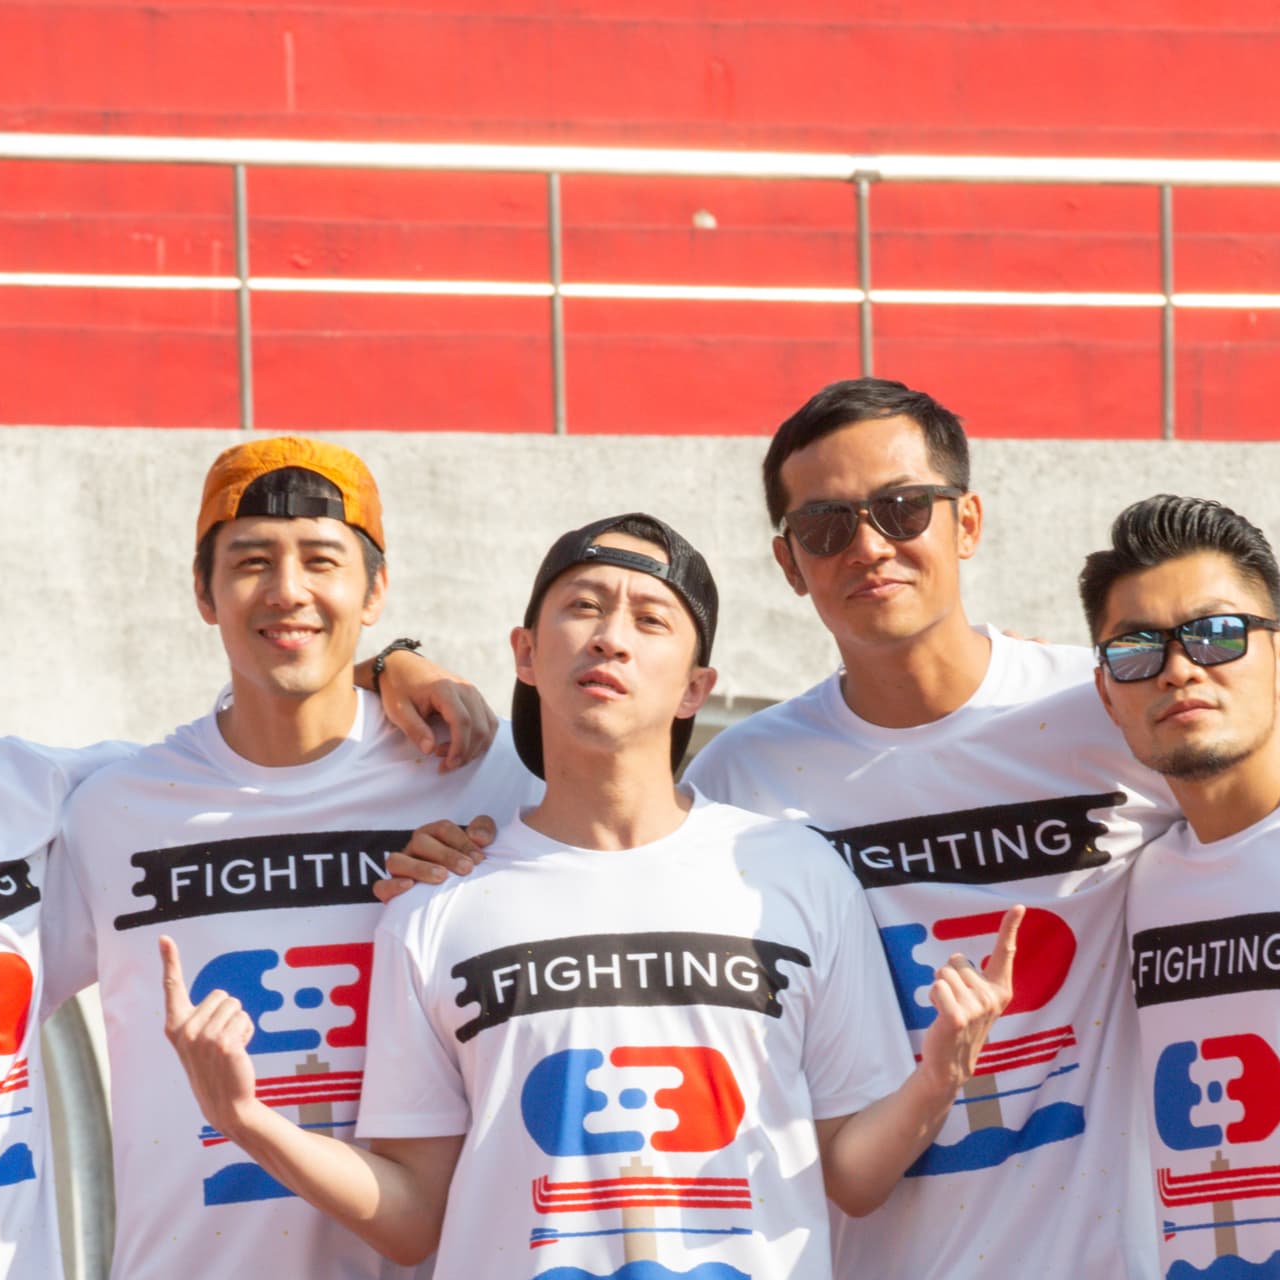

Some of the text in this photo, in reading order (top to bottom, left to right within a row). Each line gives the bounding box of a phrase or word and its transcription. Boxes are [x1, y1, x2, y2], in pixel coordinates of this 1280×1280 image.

[830, 819, 1072, 873] IGHTING
[171, 851, 393, 902] FIGHTIN
[492, 951, 760, 1004] FIGHTING
